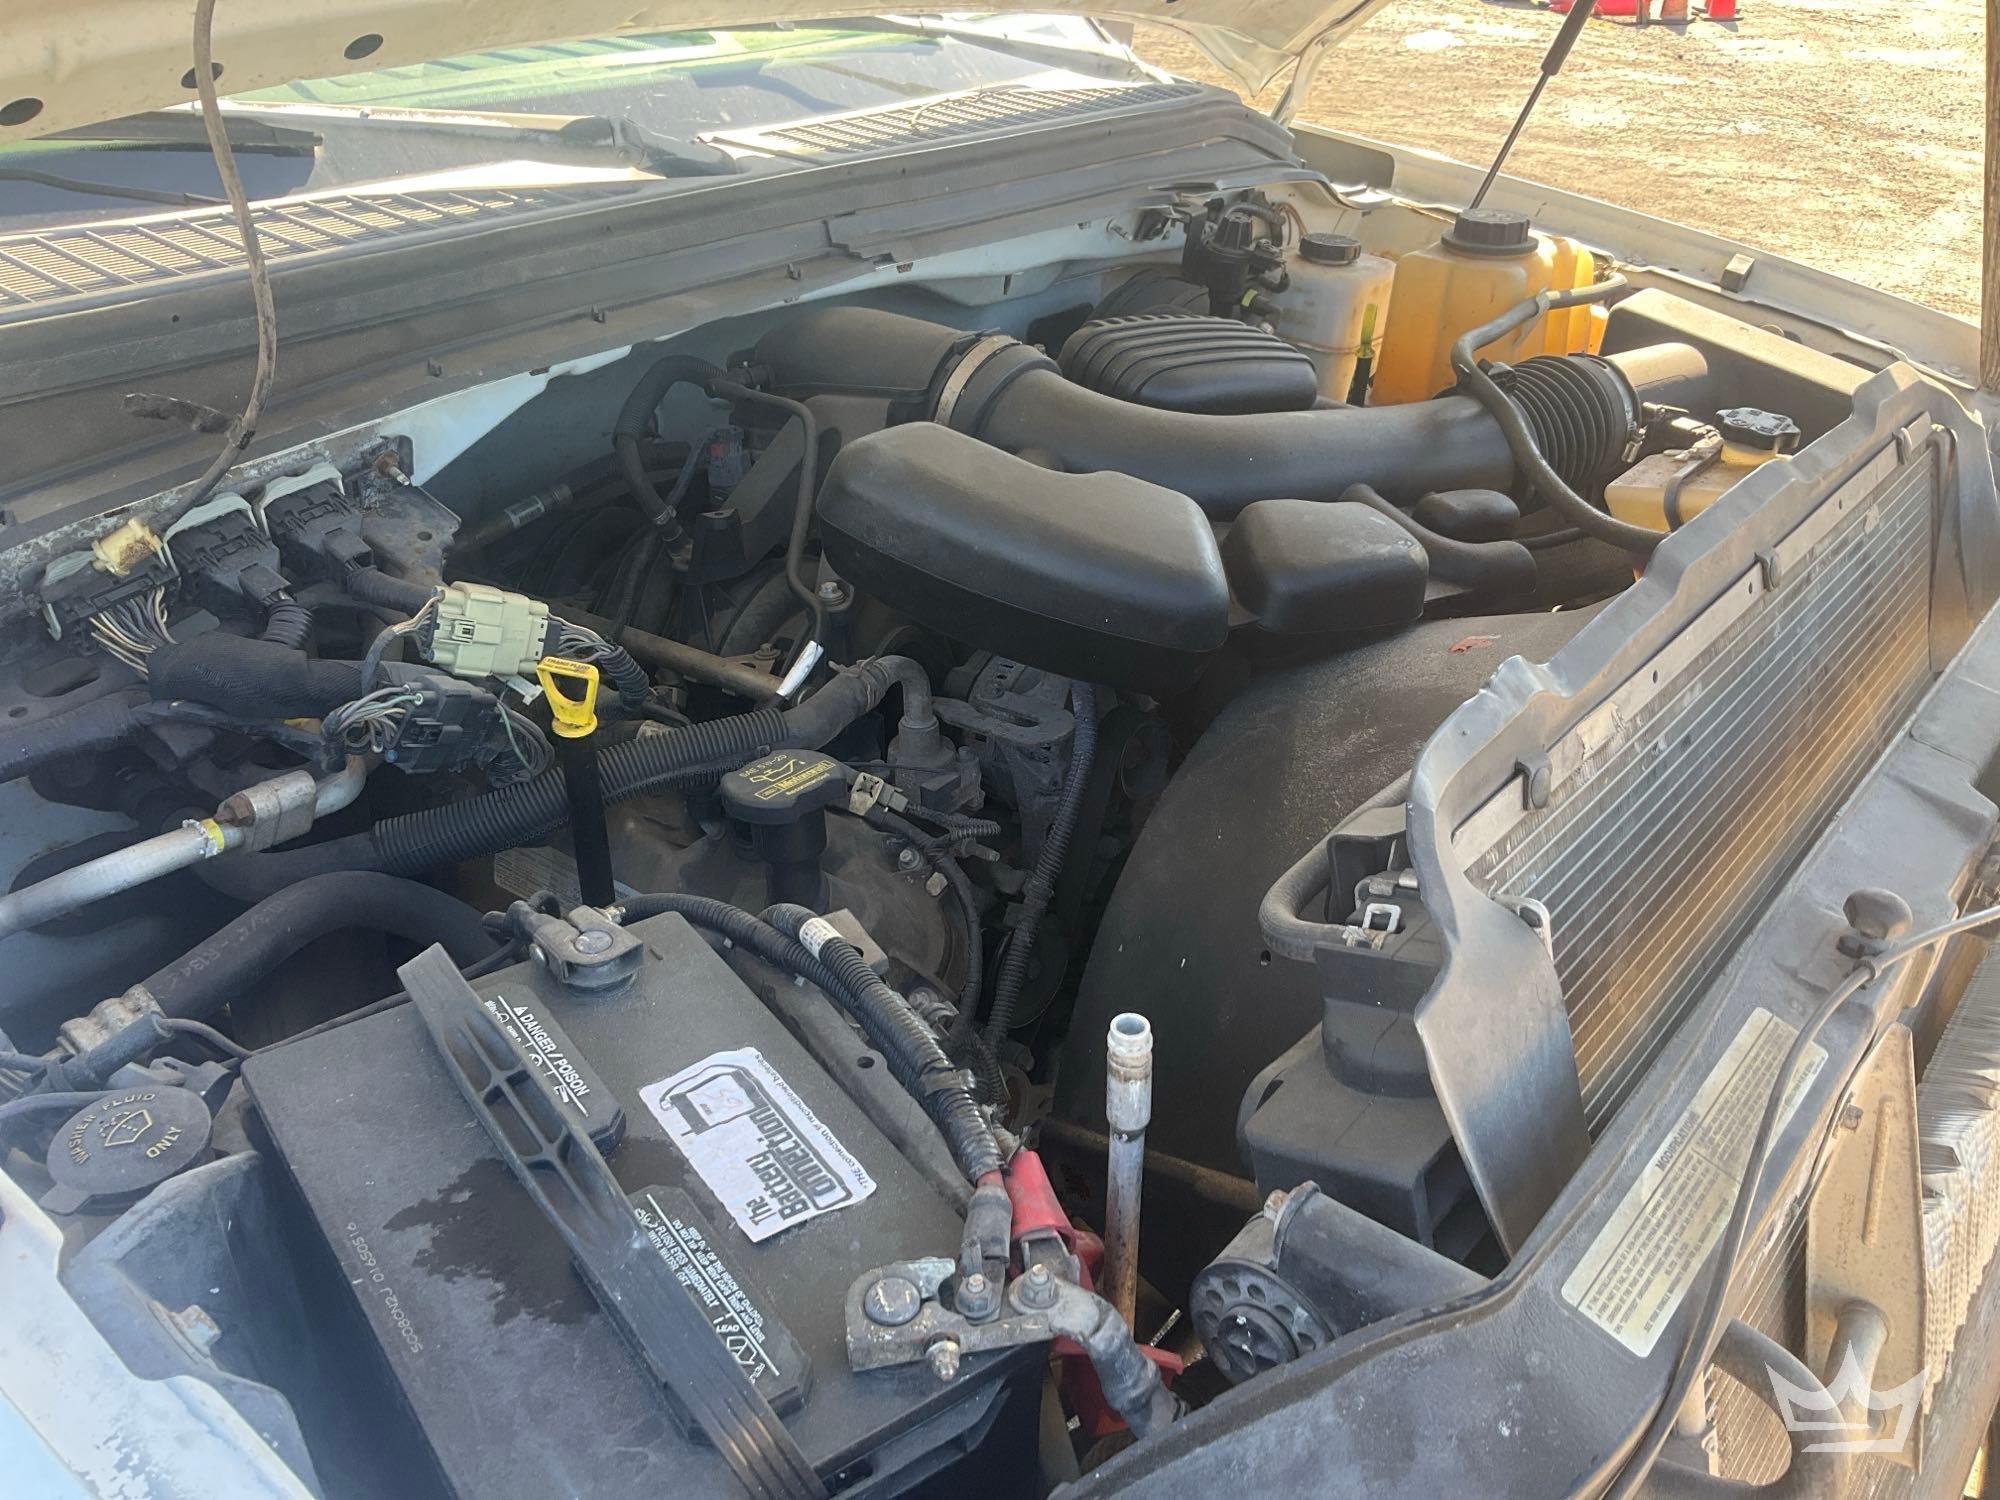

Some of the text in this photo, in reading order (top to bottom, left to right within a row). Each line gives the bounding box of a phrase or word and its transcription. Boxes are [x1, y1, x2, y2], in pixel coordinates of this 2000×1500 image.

[520, 1013, 557, 1054] DANGER
[554, 1058, 590, 1097] POISON
[68, 1092, 156, 1164] WASHER FLUID
[145, 1126, 183, 1158] ONLY
[745, 1152, 810, 1220] Battery
[745, 1195, 776, 1226] The
[656, 1226, 675, 1249] FLUSH
[671, 1247, 688, 1266] EYES
[716, 1324, 739, 1334] LEAD
